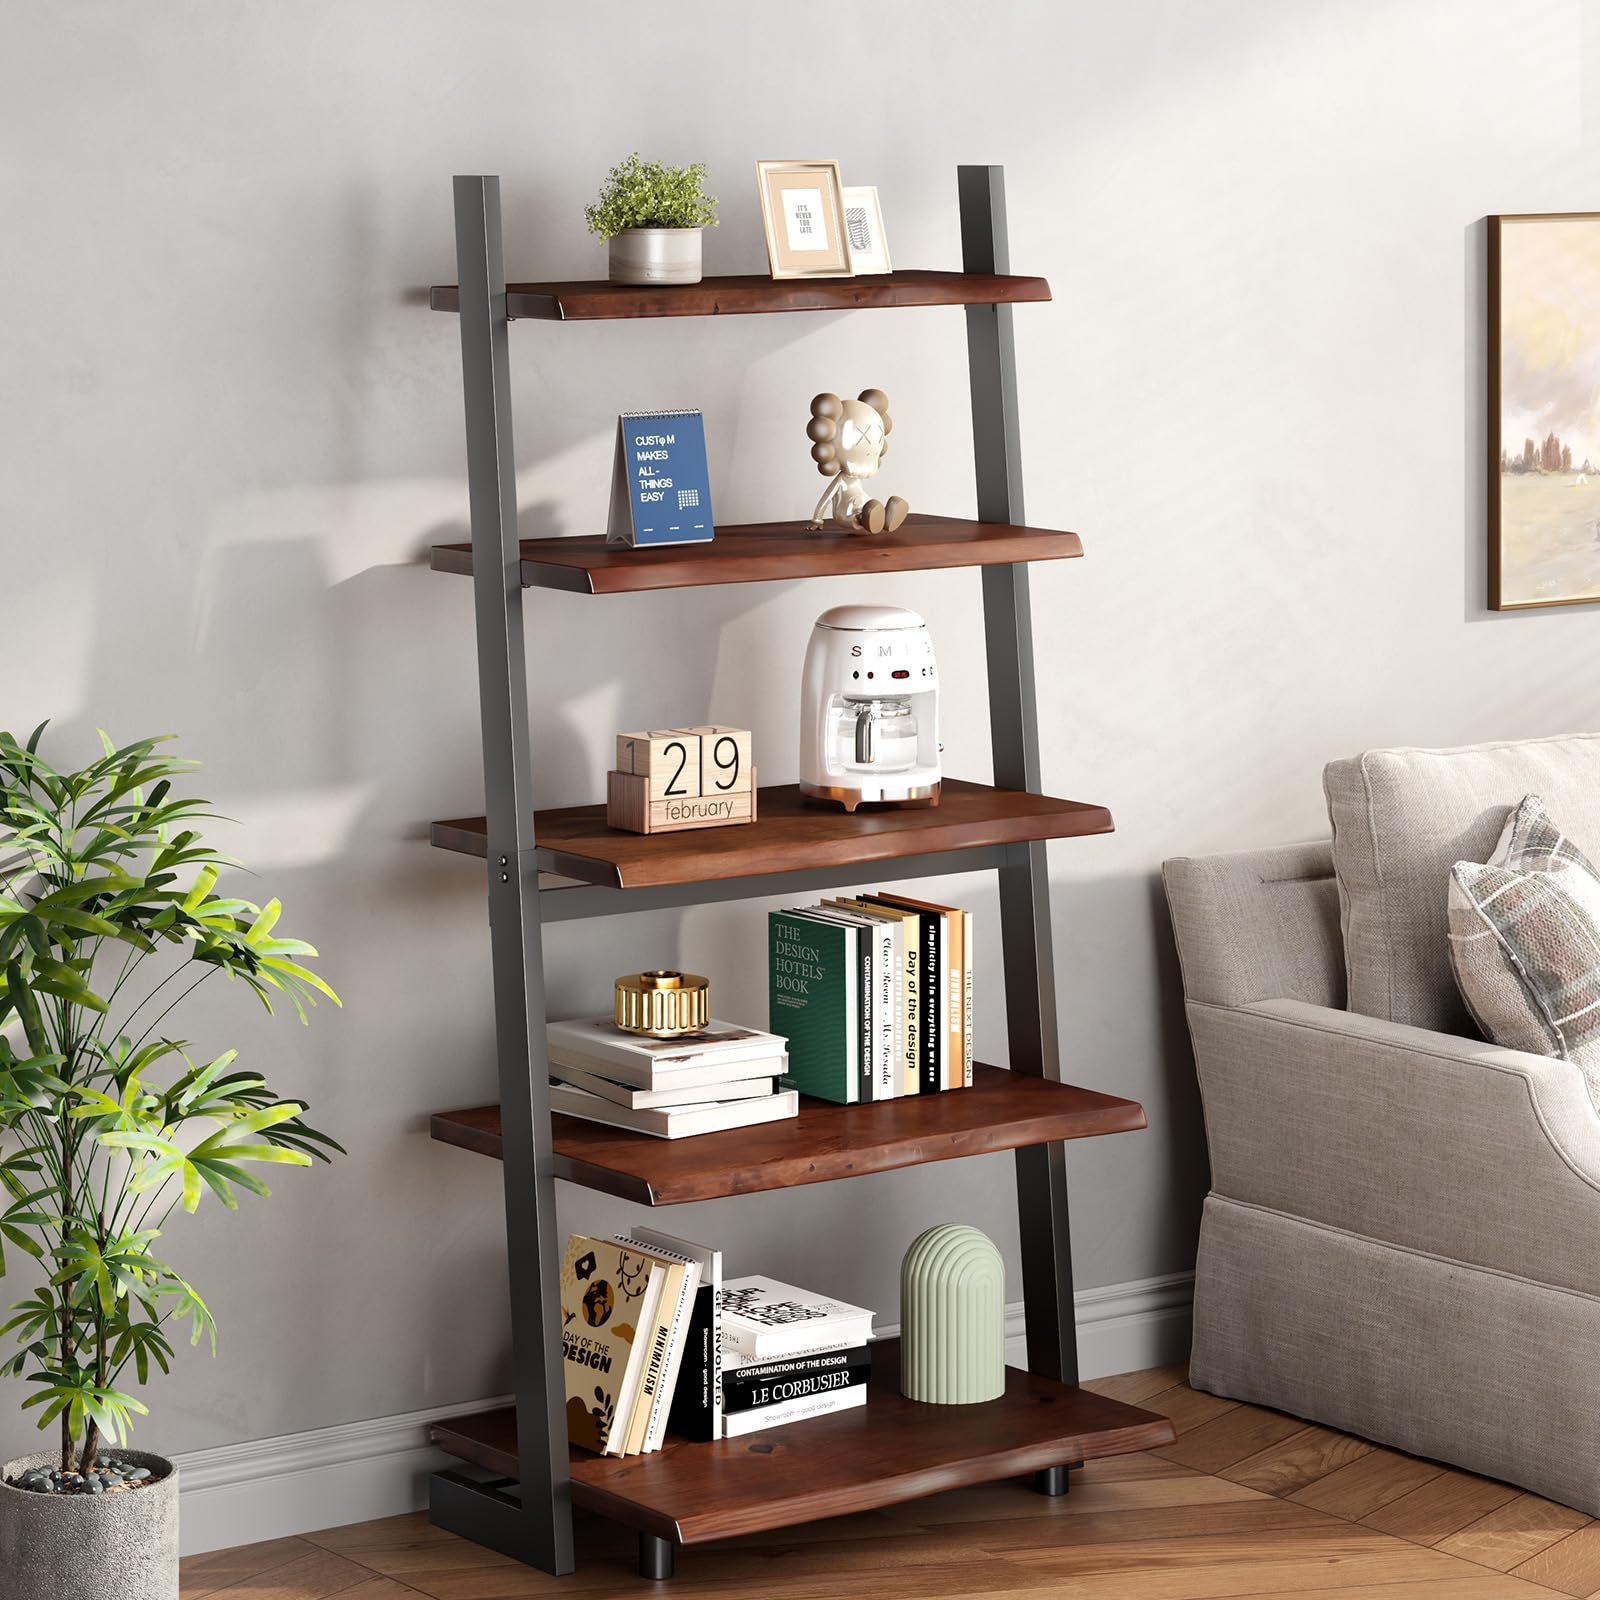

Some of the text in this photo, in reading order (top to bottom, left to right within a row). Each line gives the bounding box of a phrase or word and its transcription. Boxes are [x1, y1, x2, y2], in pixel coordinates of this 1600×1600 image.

[636, 450, 668, 461] MAKES
[639, 478, 673, 489] THINGS
[640, 492, 664, 502] EASY
[665, 800, 734, 820] february
[776, 924, 800, 941] THE
[776, 941, 820, 962] DESIGN
[928, 925, 936, 972] simplicity
[776, 974, 808, 994] BOOK
[929, 974, 936, 983] is
[929, 986, 936, 995] in
[950, 968, 960, 1033] MINIMALISM
[906, 951, 917, 1069] Day of the design
[864, 1020, 871, 1030] OF
[928, 998, 936, 1048] everything
[929, 1051, 935, 1064] we
[563, 1331, 610, 1356] DAY OF THE
[563, 1342, 612, 1373] DESIGN
[644, 1326, 668, 1396] MINIMALISM
[736, 1356, 847, 1378] CONTAMINATION OF THE DESIGN
[752, 1370, 850, 1406] LE CORBUSIER
[764, 1410, 796, 1423] Showroom
[801, 1406, 816, 1416] good
[816, 1400, 836, 1412] design
